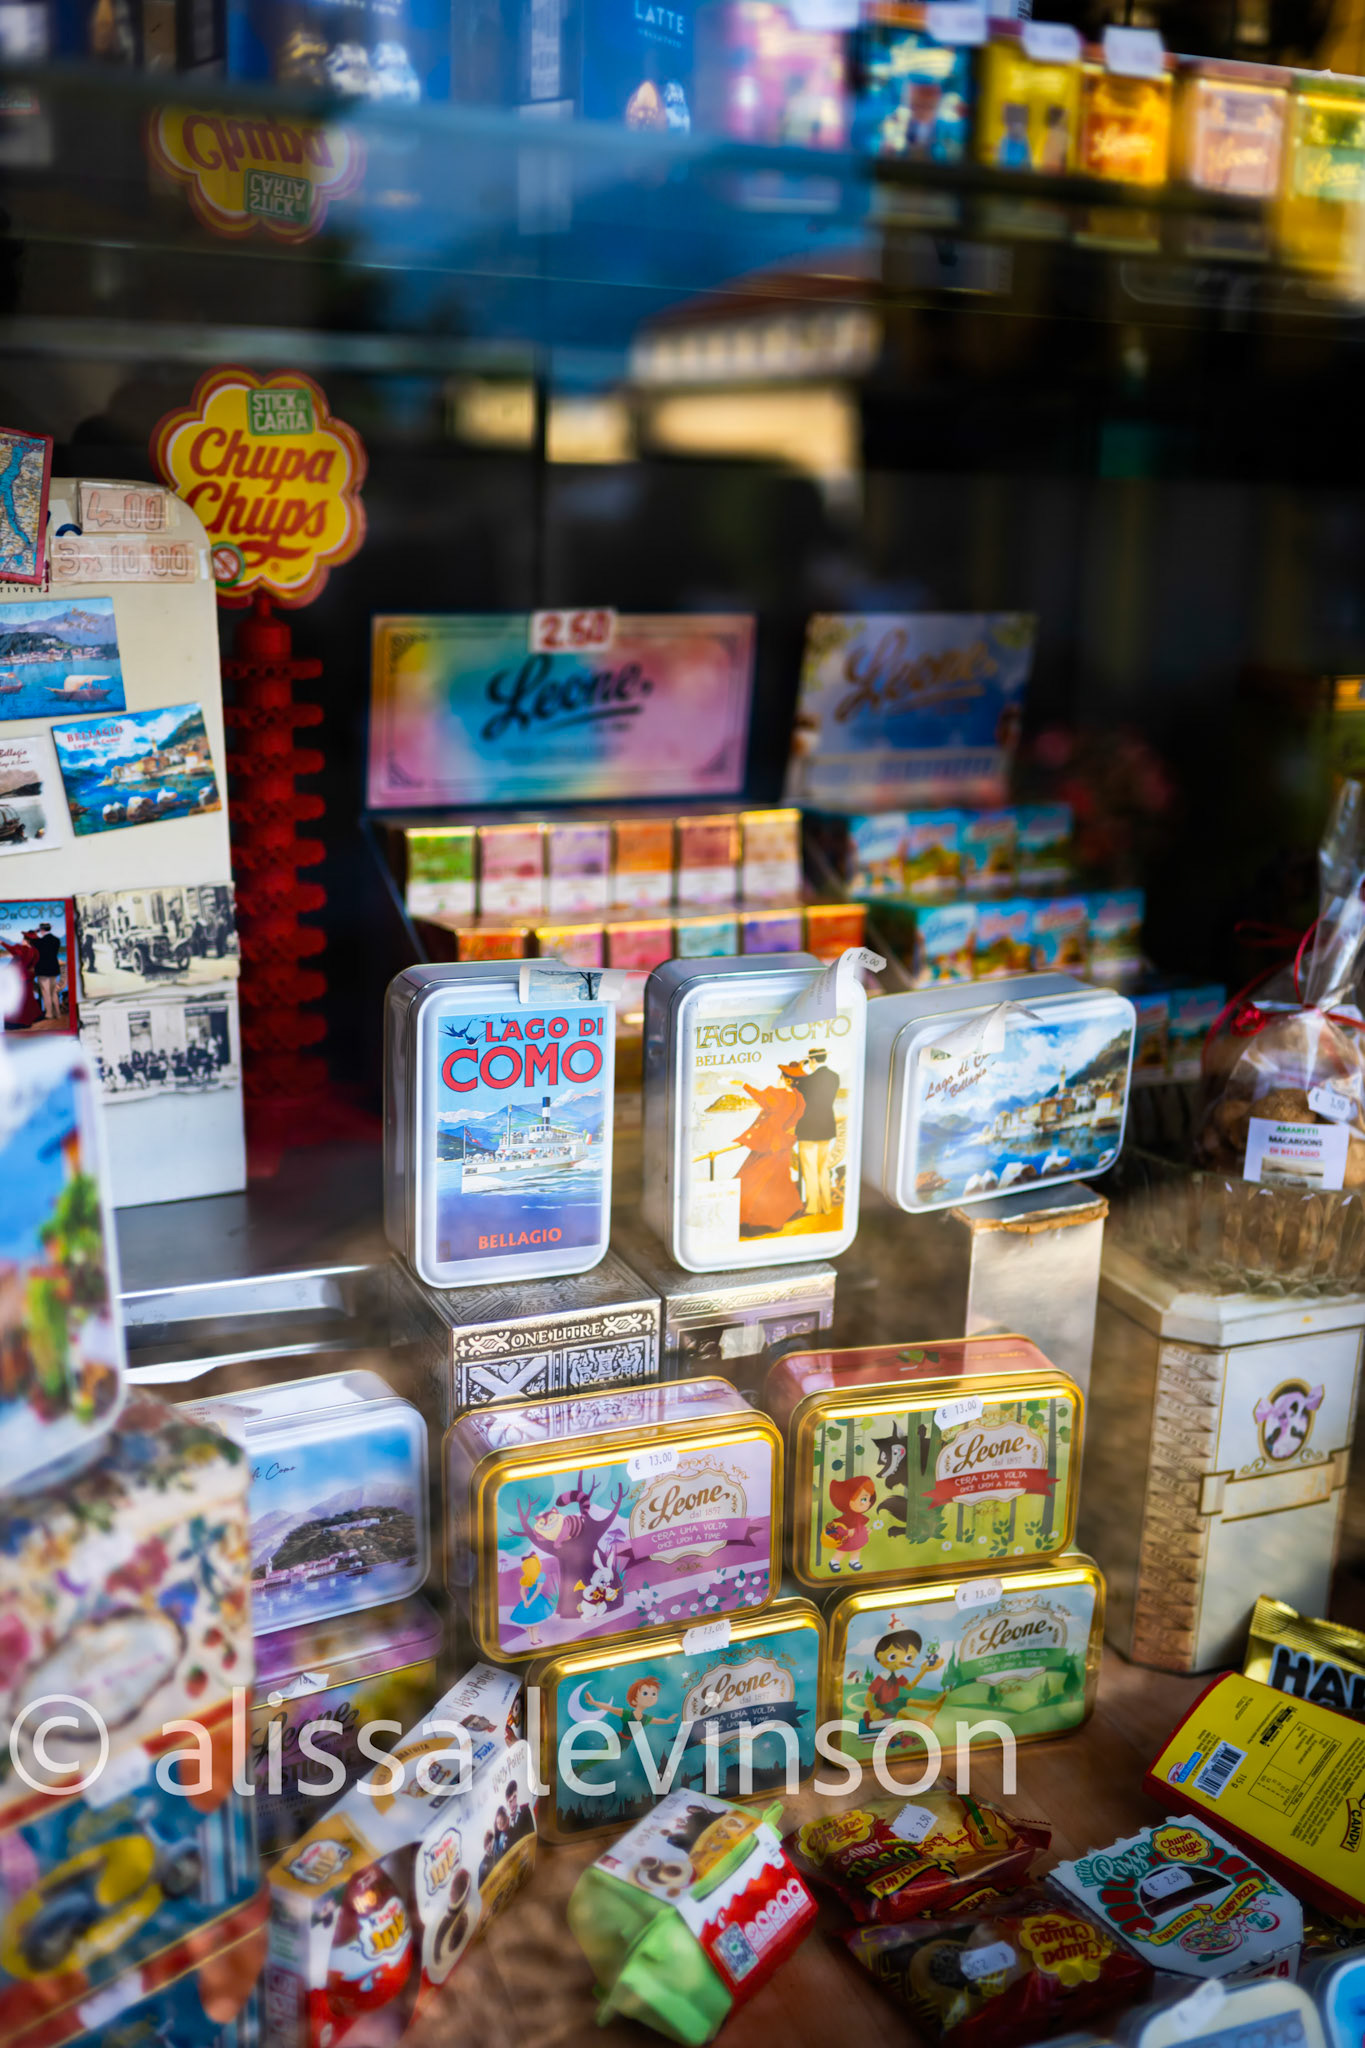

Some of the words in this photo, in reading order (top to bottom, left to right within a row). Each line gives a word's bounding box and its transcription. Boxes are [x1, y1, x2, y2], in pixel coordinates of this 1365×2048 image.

[634, 0, 685, 35] LATTE
[253, 393, 297, 411] STICK
[253, 412, 308, 431] CARTA
[189, 427, 337, 495] Chupa
[87, 491, 163, 530] 4.00
[184, 481, 329, 548] Chups
[58, 542, 81, 576] 3
[67, 725, 124, 743] BELLAGIO
[18, 904, 65, 919] COMO
[485, 1016, 569, 1043] LAGO
[579, 1017, 604, 1037] DI
[695, 1022, 760, 1049] LAGO
[761, 1031, 774, 1044] DI
[442, 1040, 603, 1093] COMO
[695, 1051, 762, 1068] BELLAGIO
[925, 1074, 954, 1101] Lago
[1268, 1135, 1323, 1147] MACAROONS
[1276, 1125, 1319, 1136] AMARETTI
[1281, 1147, 1320, 1158] BELLAGIO
[478, 1227, 563, 1250] BELLAGIO
[511, 1330, 550, 1348] ONE
[553, 1323, 602, 1342] LITRE
[955, 1400, 977, 1415] 13.00
[634, 1458, 641, 1471] €
[649, 1451, 673, 1467] 13.00
[952, 1433, 1032, 1474] Leone
[265, 1462, 297, 1481] Como
[1004, 1470, 1028, 1479] VOLTA
[648, 1484, 731, 1530] Leone
[695, 1534, 702, 1542] A
[704, 1532, 721, 1541] TIME
[703, 1521, 729, 1531] VOLTA
[703, 1622, 725, 1636] 13.00
[976, 1618, 1053, 1655] Leone
[700, 1671, 779, 1716] Leone
[752, 1706, 777, 1716] VOLTA
[916, 1813, 932, 1829] 2.50
[1346, 1809, 1362, 1850] CANDY
[1160, 1831, 1193, 1849] Chupa
[1168, 1840, 1203, 1857] Chups
[840, 1839, 883, 1866] CANDY
[1092, 1843, 1150, 1882] Pizza
[1166, 1871, 1185, 1886] 2.50
[1214, 1897, 1238, 1921] CANDY
[1236, 1882, 1259, 1901] PIZZA
[1030, 1920, 1091, 1946] Chups
[1156, 1926, 1175, 1942] FUN
[1172, 1919, 1184, 1932] TO
[1180, 1911, 1195, 1926] EAT
[1258, 1917, 1273, 1931] ME
[1040, 1940, 1101, 1966] Chupa
